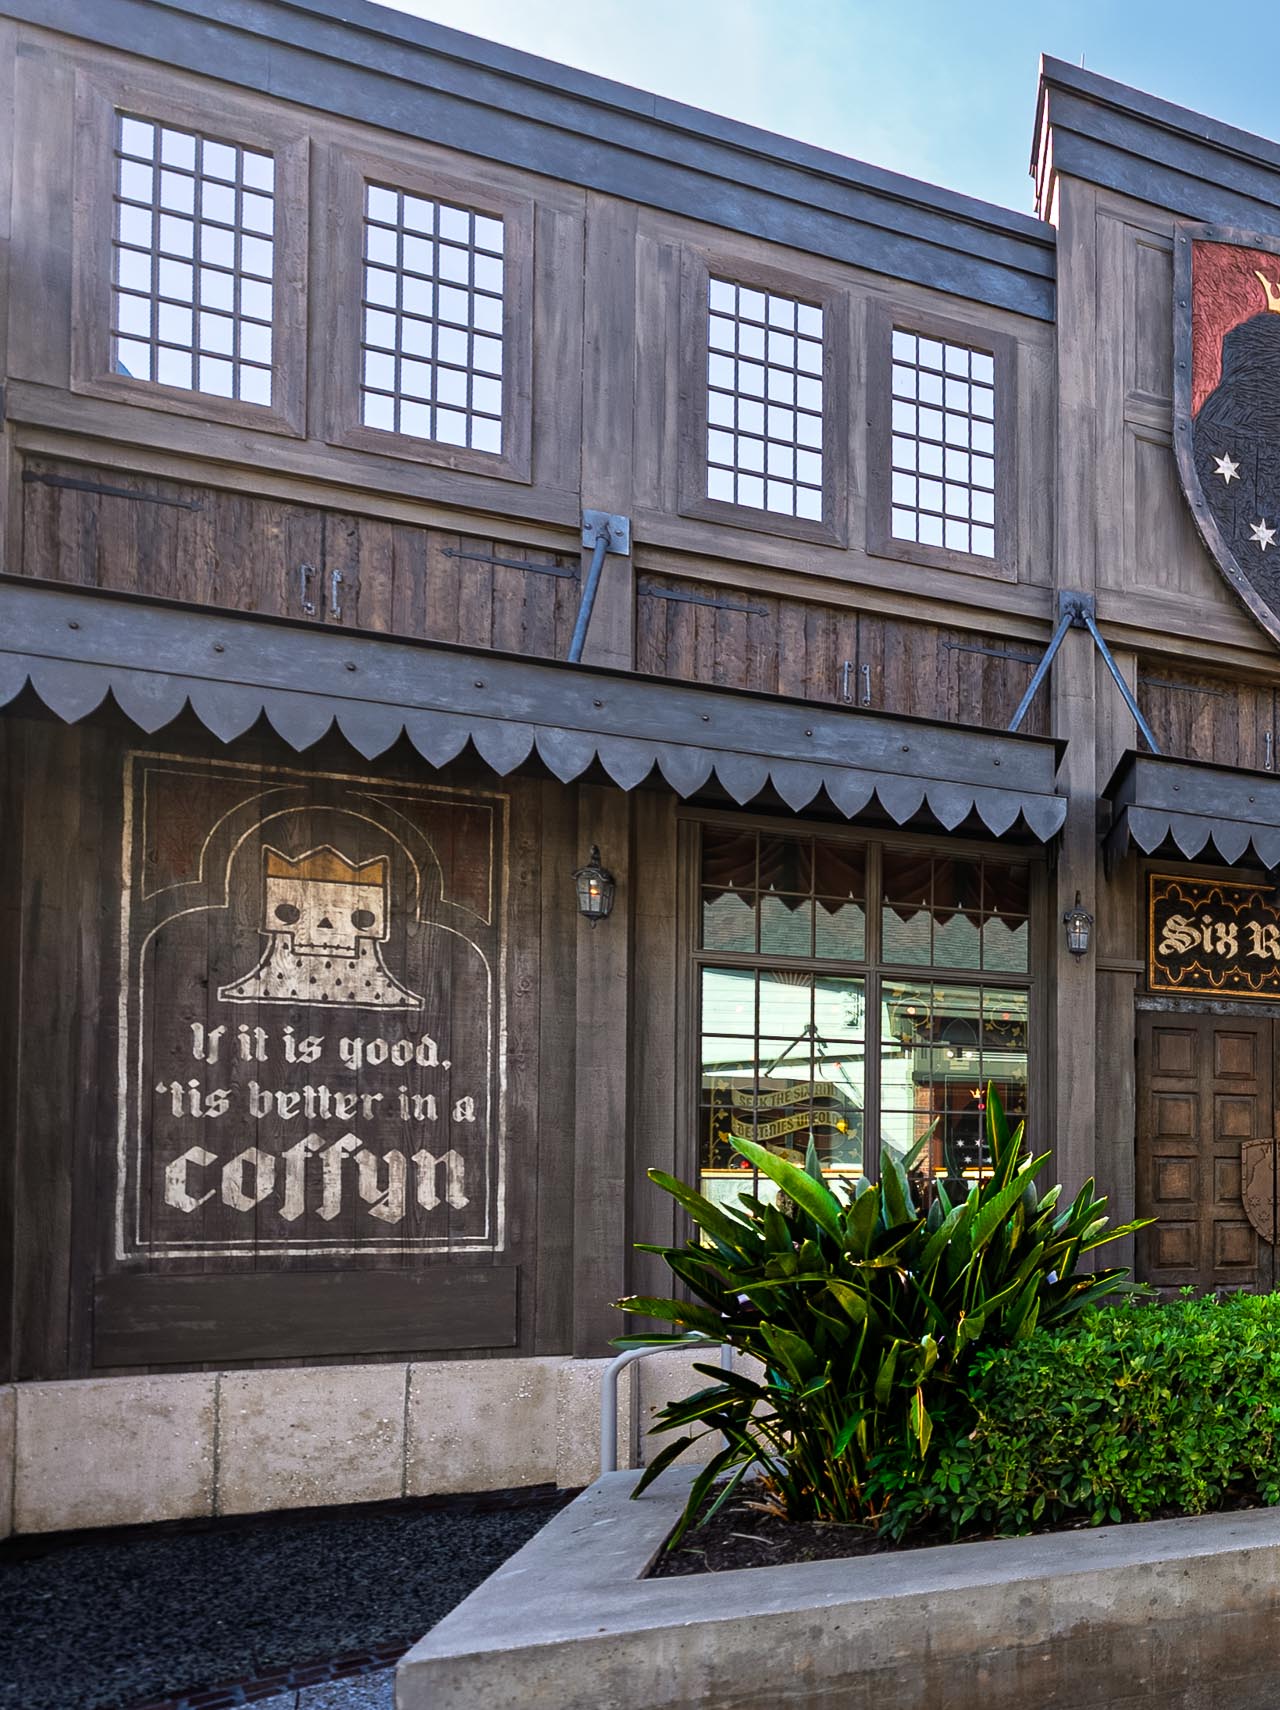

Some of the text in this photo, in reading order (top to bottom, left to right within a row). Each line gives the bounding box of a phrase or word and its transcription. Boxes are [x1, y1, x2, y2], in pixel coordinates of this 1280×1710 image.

[1158, 914, 1239, 959] Six
[237, 1023, 268, 1062] it
[282, 1025, 325, 1064] is
[248, 1080, 384, 1121] better
[398, 1085, 438, 1121] in
[452, 1094, 476, 1123] a
[739, 1095, 769, 1107] SEK
[771, 1089, 792, 1107] THE
[164, 1132, 470, 1225] coffyn
